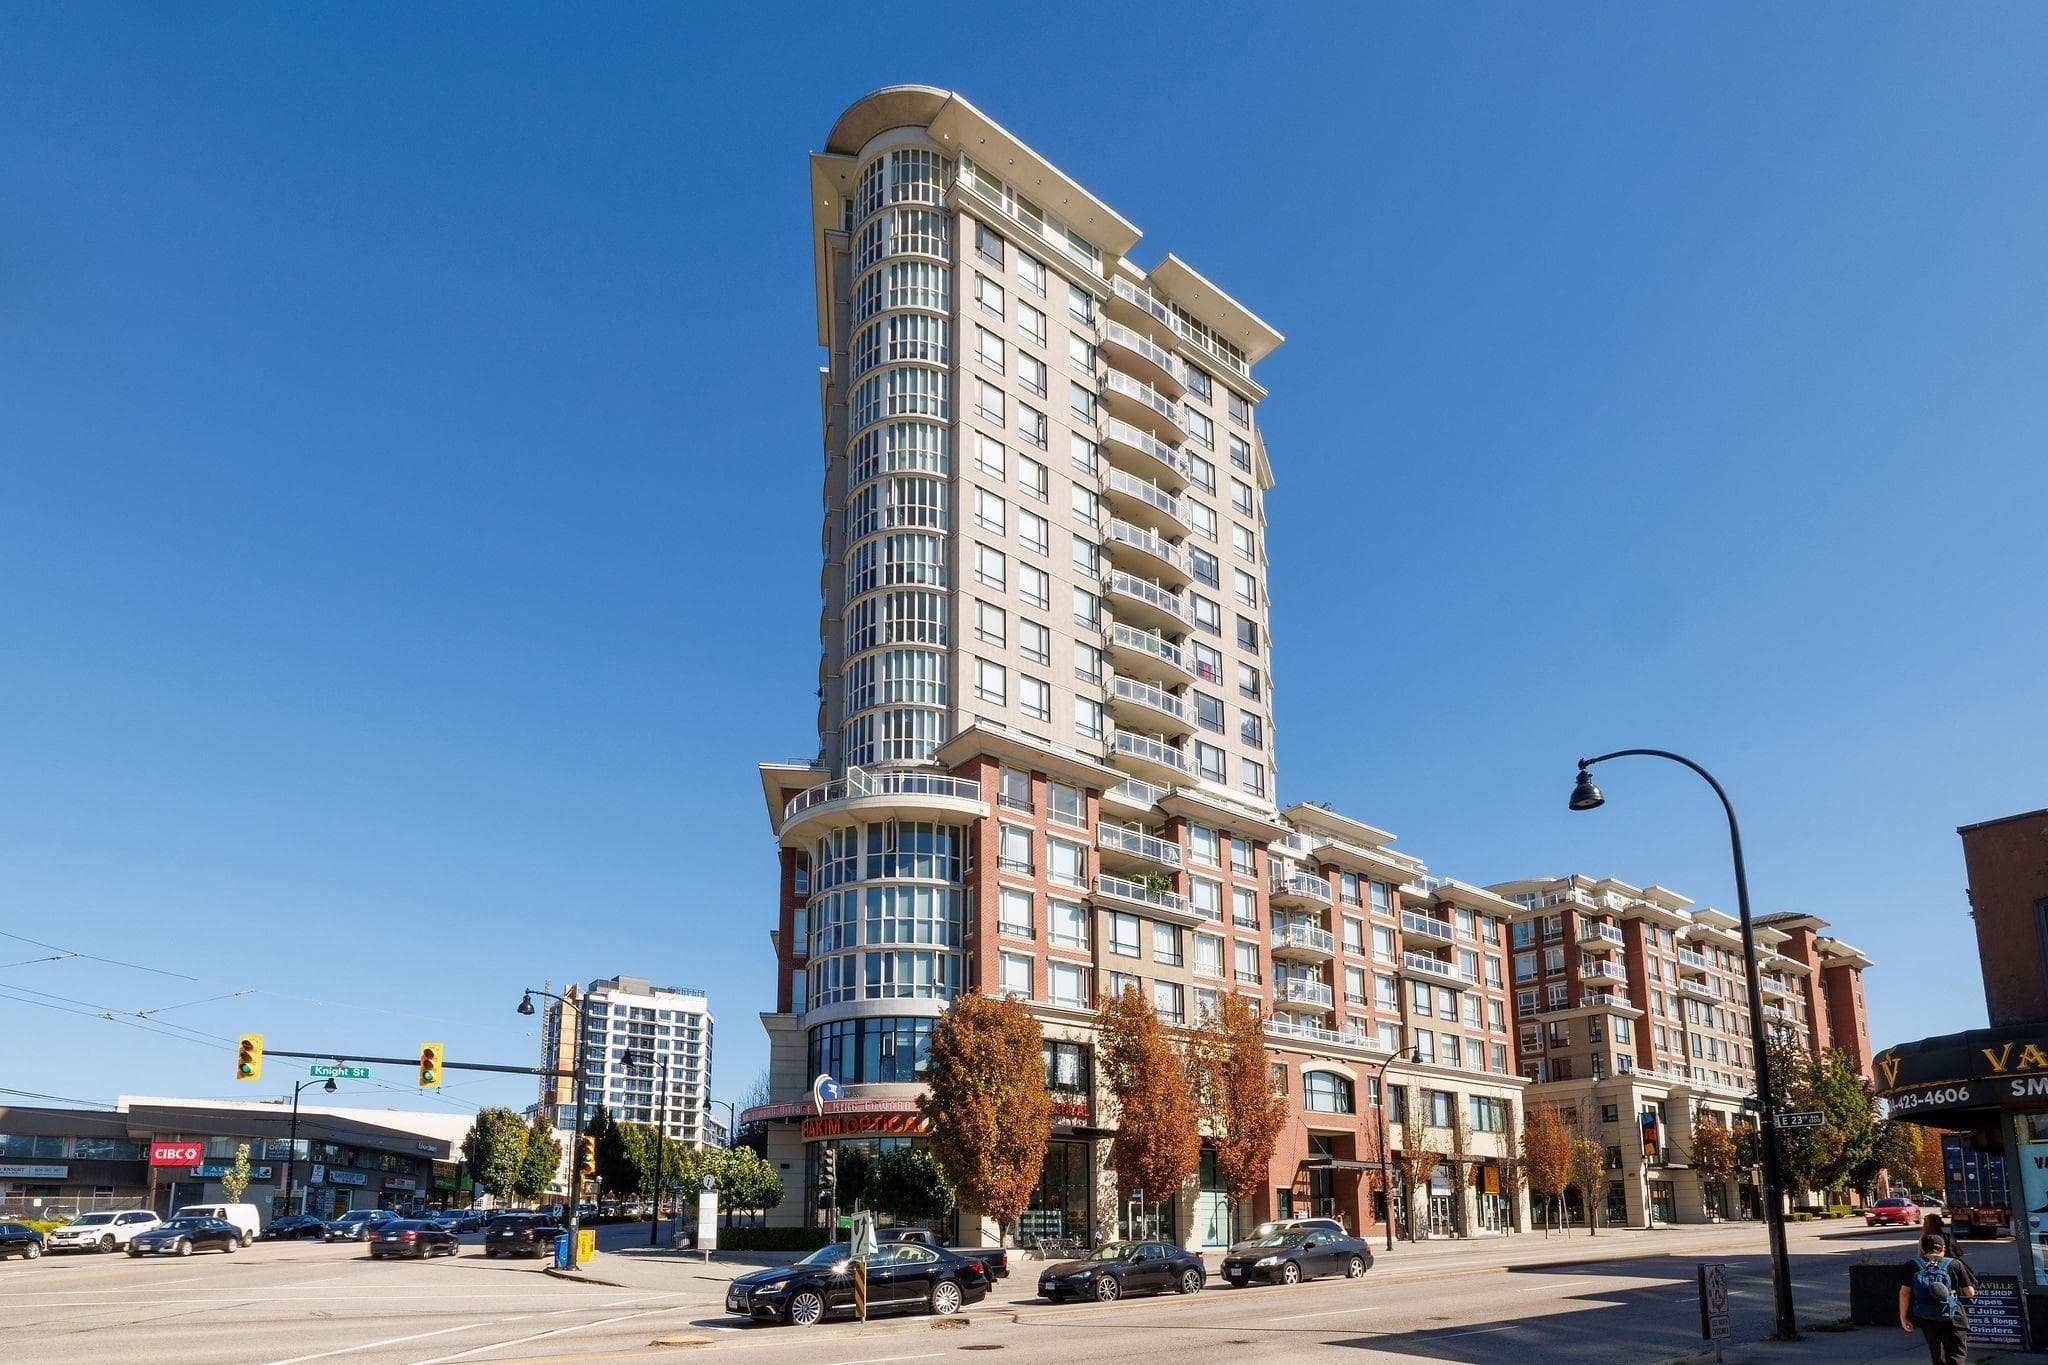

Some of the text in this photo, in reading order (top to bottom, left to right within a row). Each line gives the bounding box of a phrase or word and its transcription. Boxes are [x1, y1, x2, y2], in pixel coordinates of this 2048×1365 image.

[315, 1066, 365, 1077] Knight St
[833, 1102, 857, 1112] KING
[1782, 1117, 1788, 1125] E
[803, 1116, 840, 1137] HAKIM
[155, 1149, 184, 1160] CIBC
[1970, 1298, 2003, 1306] Vapes
[1993, 1317, 2018, 1326] Bongs
[1970, 1326, 2013, 1334] Grinders
